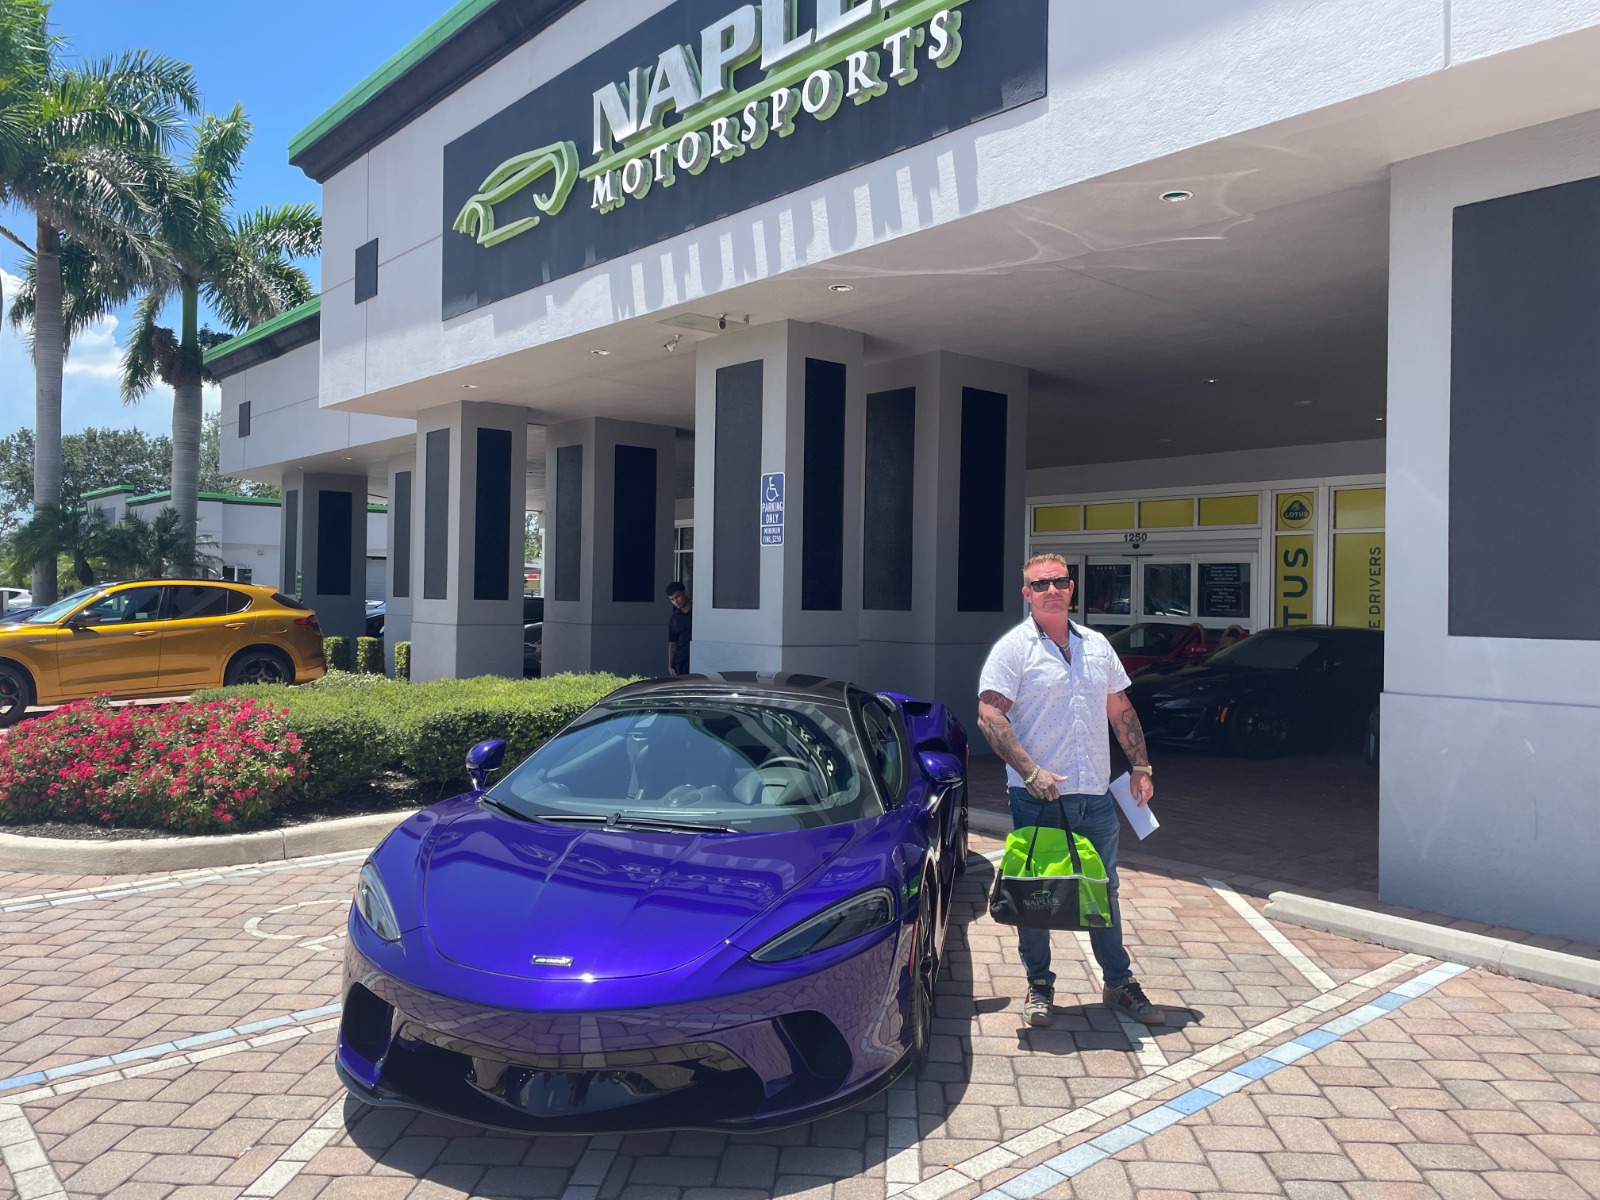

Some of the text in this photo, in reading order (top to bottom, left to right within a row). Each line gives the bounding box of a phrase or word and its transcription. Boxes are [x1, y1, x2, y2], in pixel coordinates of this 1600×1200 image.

[591, 0, 906, 155] NAPL
[590, 9, 953, 210] MOTORSPORTS
[762, 501, 783, 513] PARKING
[766, 514, 779, 523] ONLY
[1285, 510, 1309, 519] LOTUS
[1123, 532, 1148, 542] 1250
[1368, 546, 1382, 615] DRIVERS
